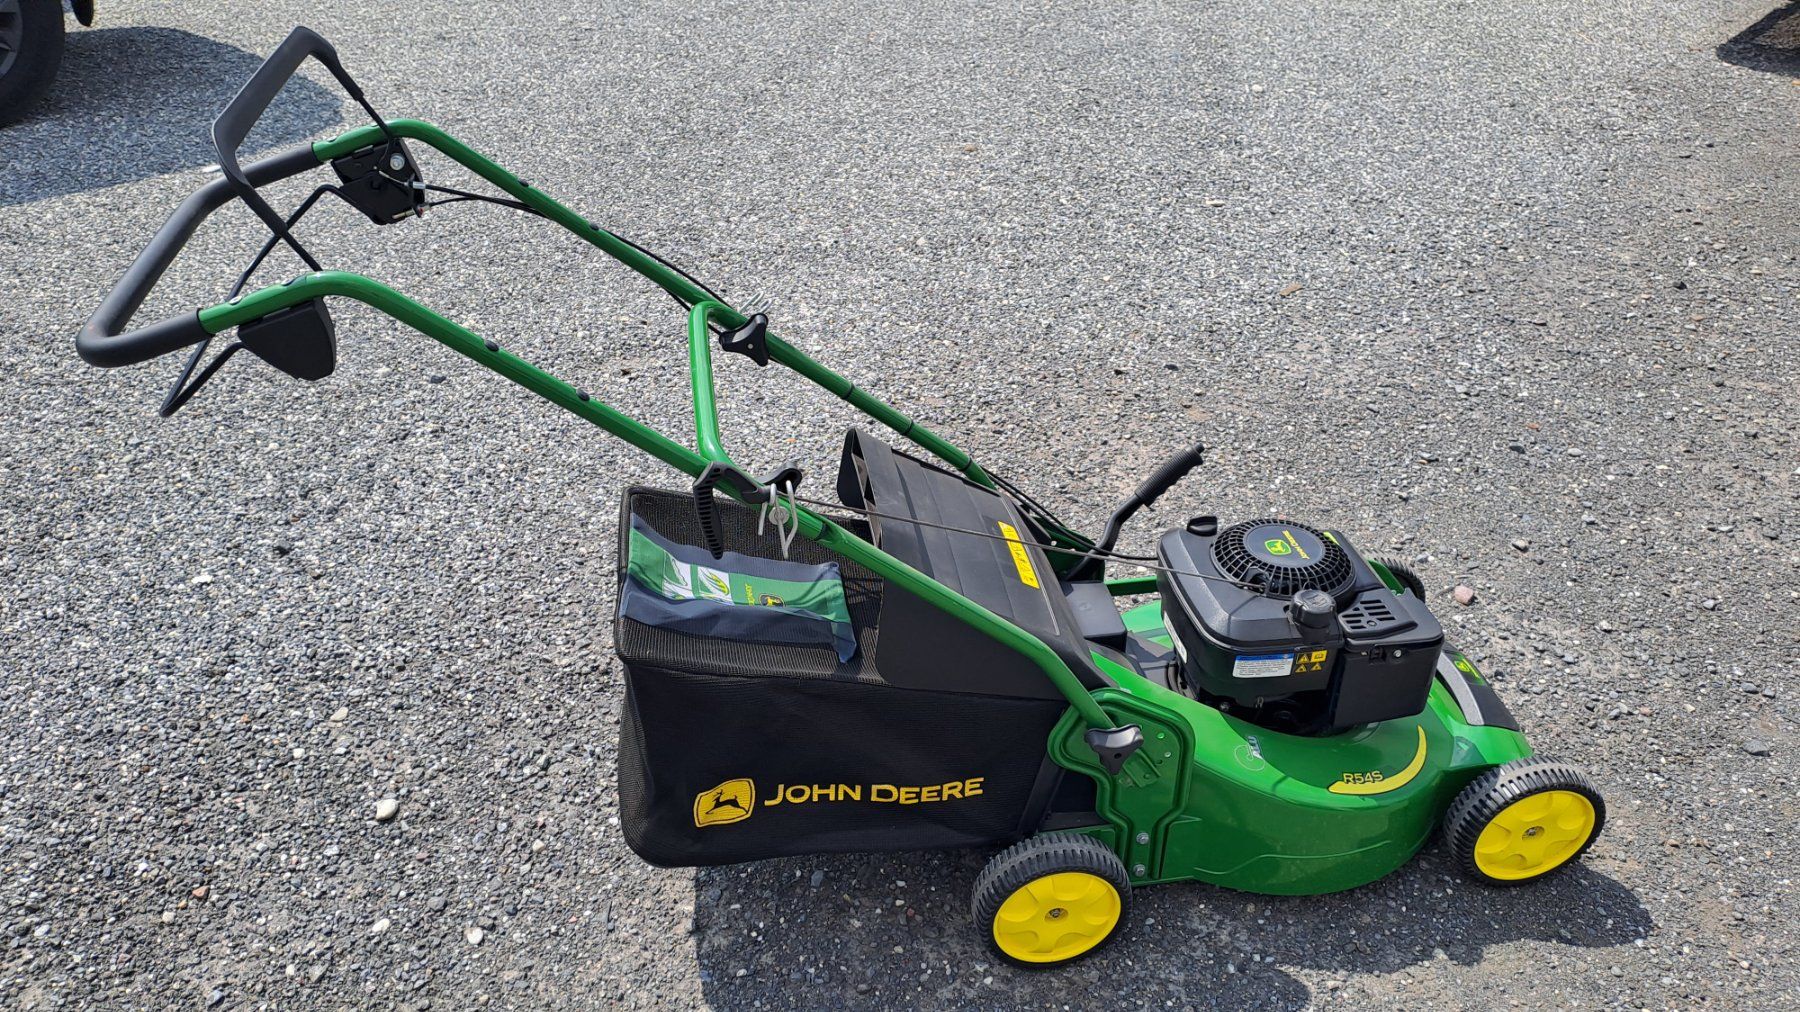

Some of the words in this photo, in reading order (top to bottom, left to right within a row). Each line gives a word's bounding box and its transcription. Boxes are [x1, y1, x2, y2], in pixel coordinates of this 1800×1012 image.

[1343, 770, 1384, 784] R54S
[764, 783, 861, 806] JOHN
[870, 777, 984, 805] DEERE
